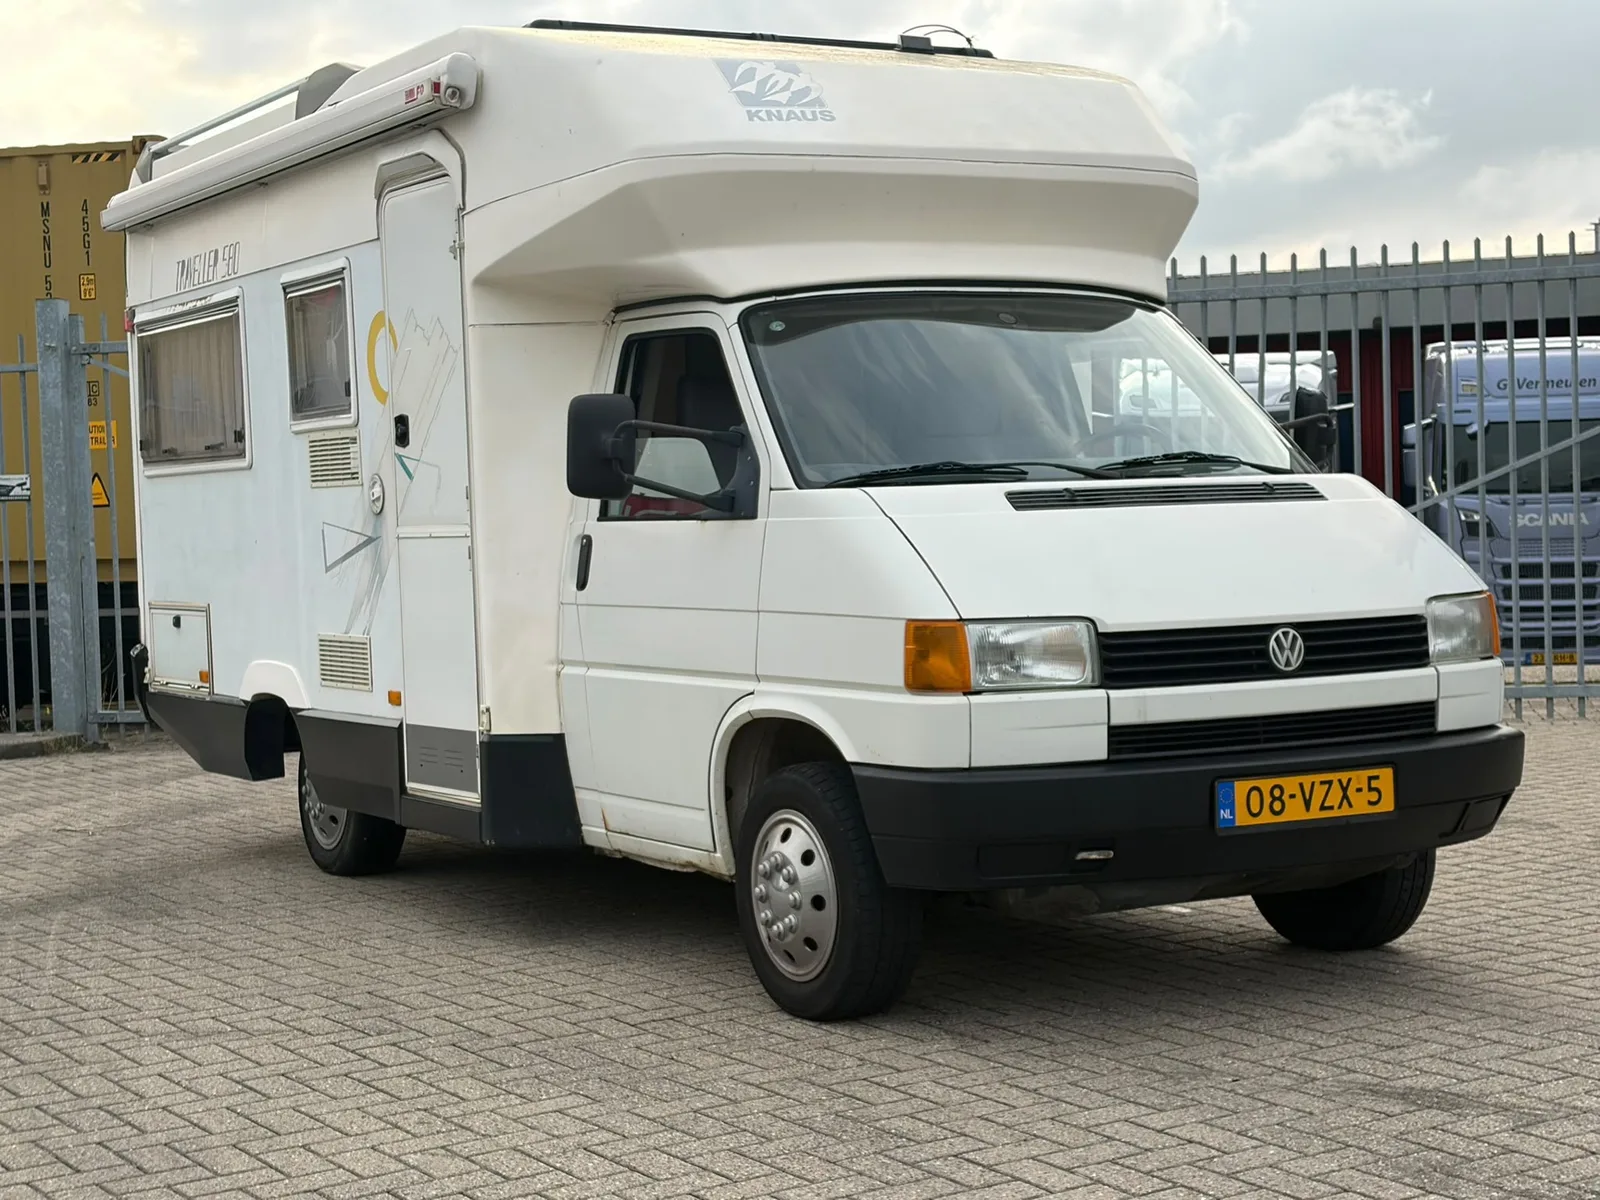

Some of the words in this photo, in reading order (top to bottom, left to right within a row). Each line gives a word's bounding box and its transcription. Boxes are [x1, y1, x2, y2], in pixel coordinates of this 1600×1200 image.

[746, 109, 837, 121] KNAUS
[81, 199, 91, 266] 45G1
[1516, 377, 1598, 390] Vermeuen
[1220, 808, 1234, 820] NL
[1246, 774, 1383, 818] 08-VZX-5
